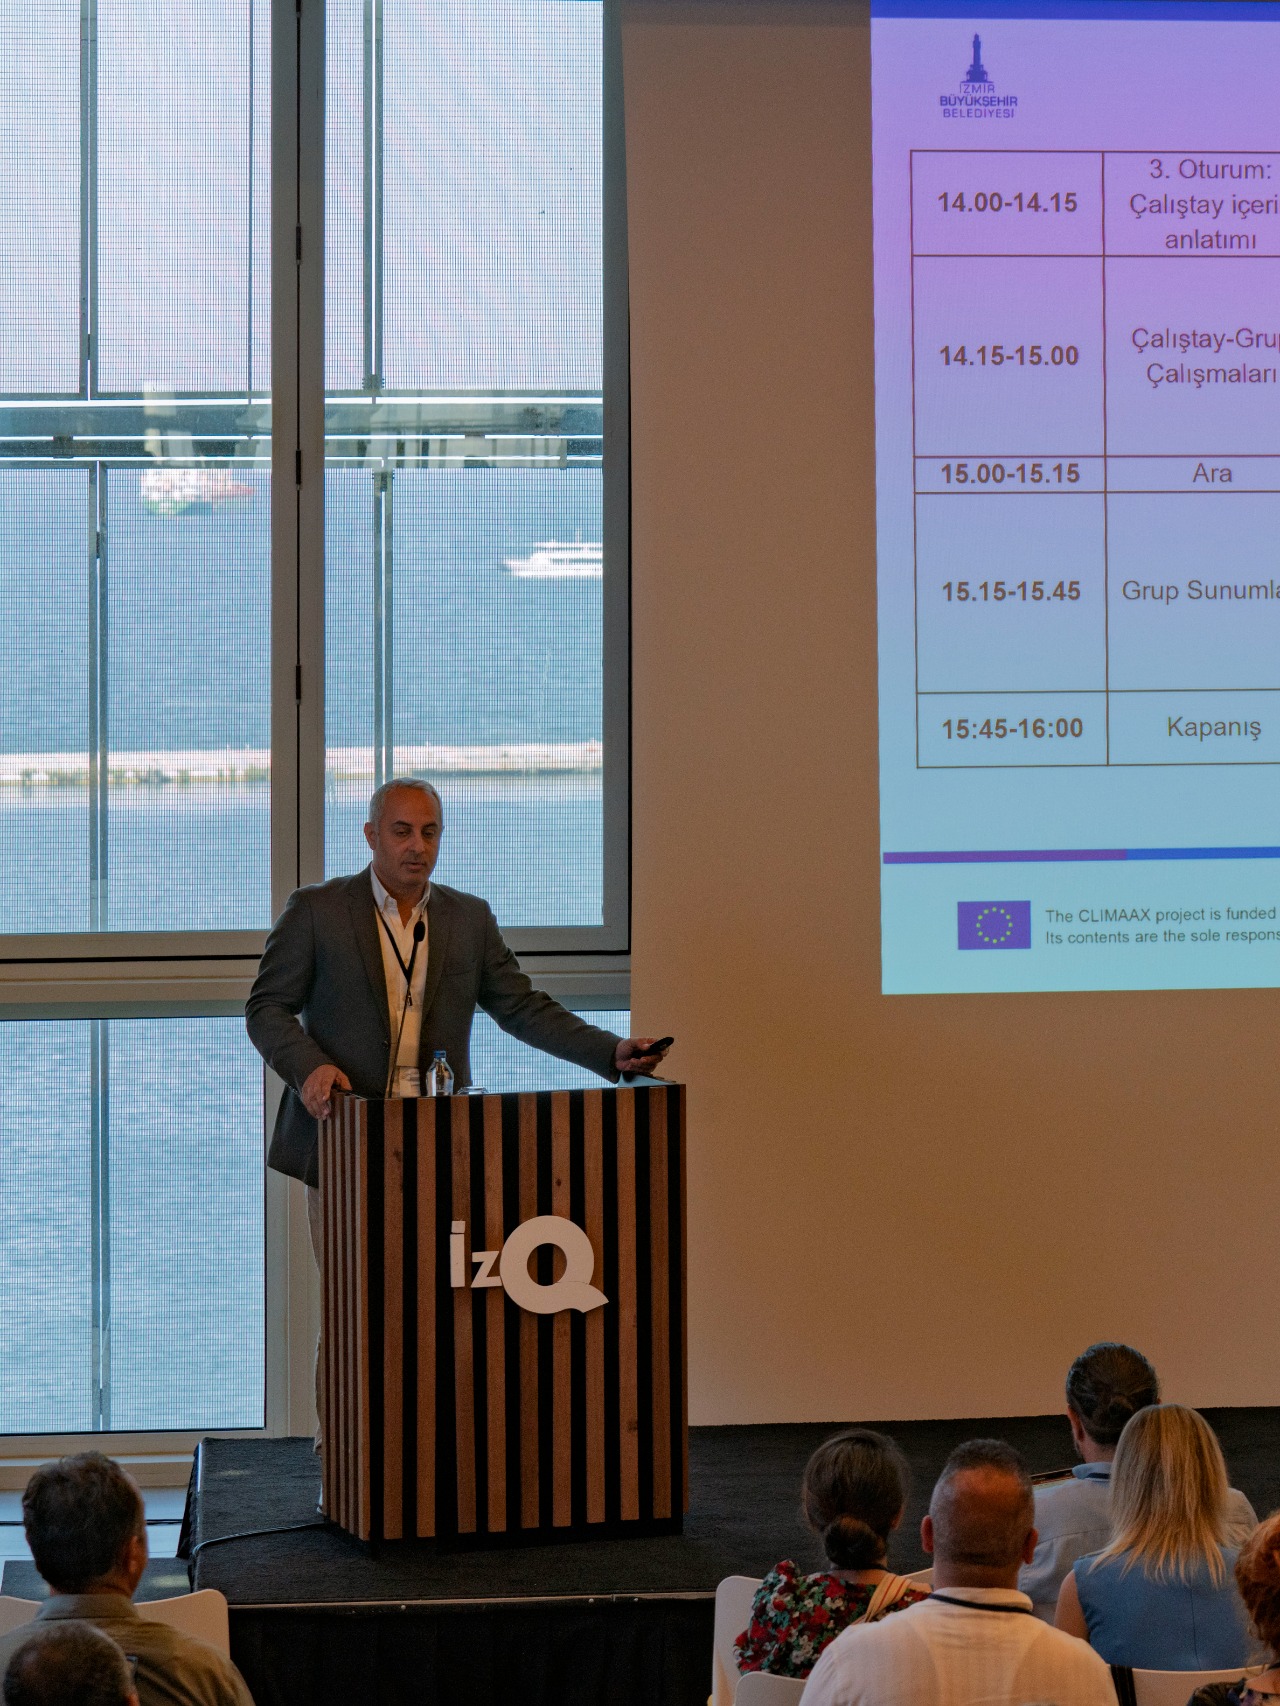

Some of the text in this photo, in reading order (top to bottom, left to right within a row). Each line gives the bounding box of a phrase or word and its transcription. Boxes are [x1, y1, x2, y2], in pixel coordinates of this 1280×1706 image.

[1149, 158, 1273, 180] 3. Oturum:
[937, 191, 1078, 213] 14.00-14.15
[1128, 192, 1225, 220] Çalıştay
[1164, 229, 1258, 251] anlatımı
[939, 344, 1080, 367] 14.15-15.00
[1145, 361, 1277, 390] Çalışmaları
[940, 462, 1081, 485] 15.00-15.15
[1191, 461, 1233, 484] Ara
[941, 579, 1081, 602] 15.15-15.45
[1120, 579, 1180, 606] Grup
[941, 716, 1084, 740] 15:45-16:00
[1166, 715, 1262, 743] Kapanış
[1044, 907, 1074, 924] The
[1077, 907, 1152, 924] CLIMAAX
[1154, 907, 1206, 925] project
[1209, 909, 1223, 922] is
[1224, 906, 1277, 921] funded
[1045, 930, 1064, 945] Its
[1066, 930, 1131, 945] contents
[1134, 931, 1159, 944] are
[1162, 928, 1187, 943] the
[1189, 927, 1221, 943] sole
